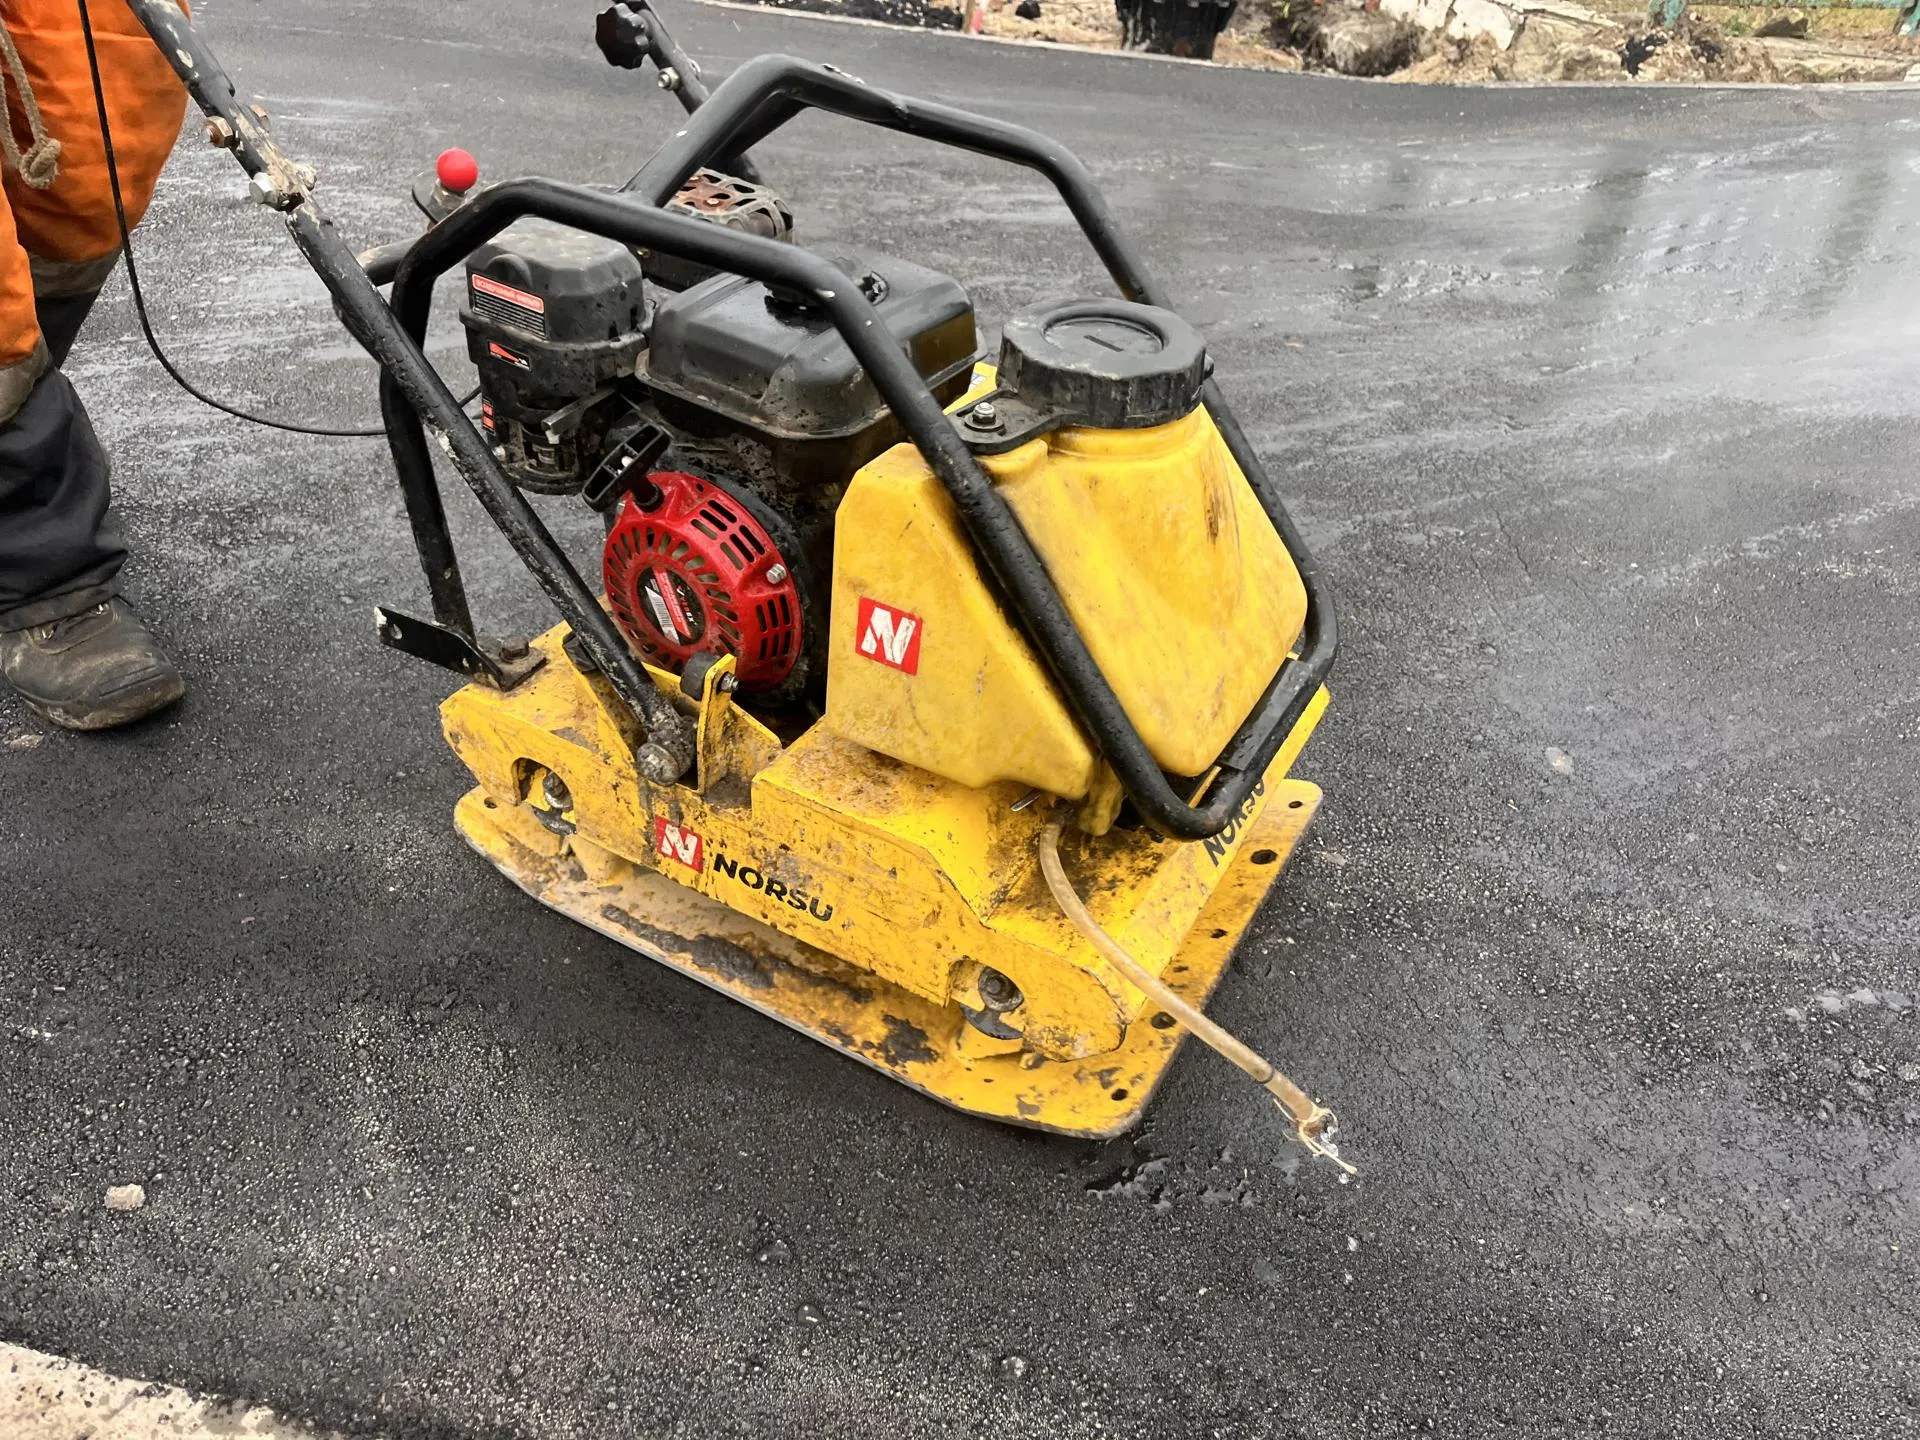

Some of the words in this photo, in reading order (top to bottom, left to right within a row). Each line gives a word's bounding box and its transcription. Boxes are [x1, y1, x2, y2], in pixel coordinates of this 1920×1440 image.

[861, 606, 917, 665] N
[661, 823, 698, 865] N
[713, 852, 834, 922] NORSU
